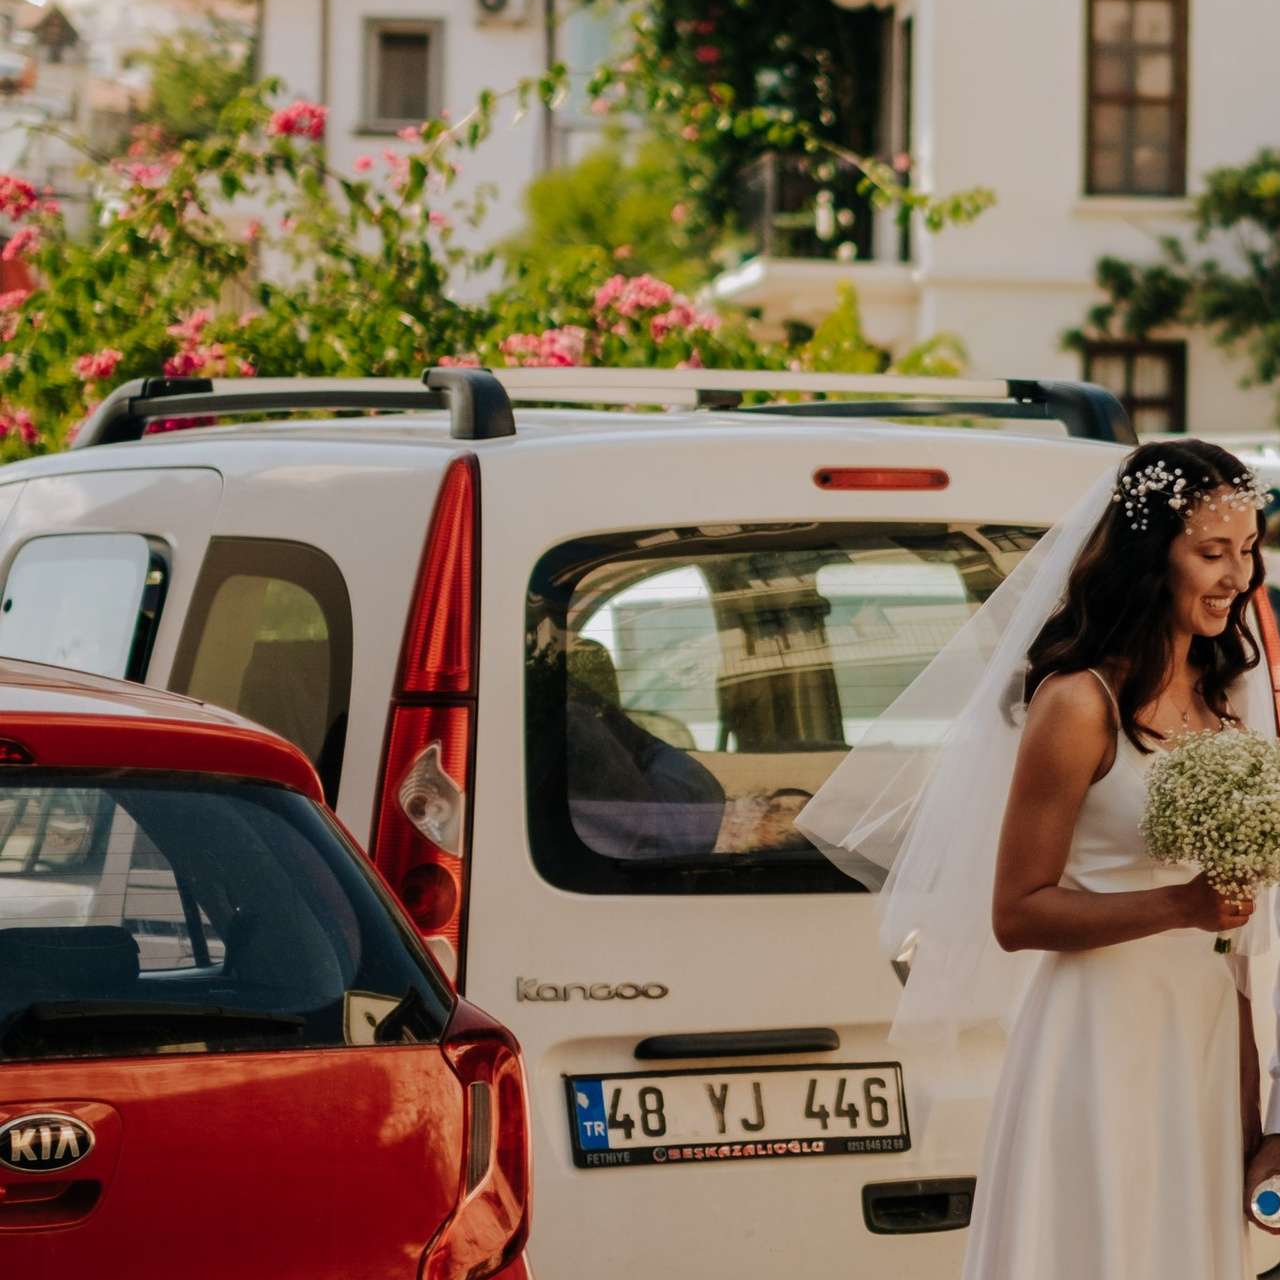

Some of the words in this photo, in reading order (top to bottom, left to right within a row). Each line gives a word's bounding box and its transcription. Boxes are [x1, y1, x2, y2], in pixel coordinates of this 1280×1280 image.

[607, 1086, 667, 1140] 48
[707, 1081, 765, 1134] YJ
[804, 1077, 890, 1130] 446
[9, 1126, 80, 1161] KIA
[583, 1122, 605, 1137] TR
